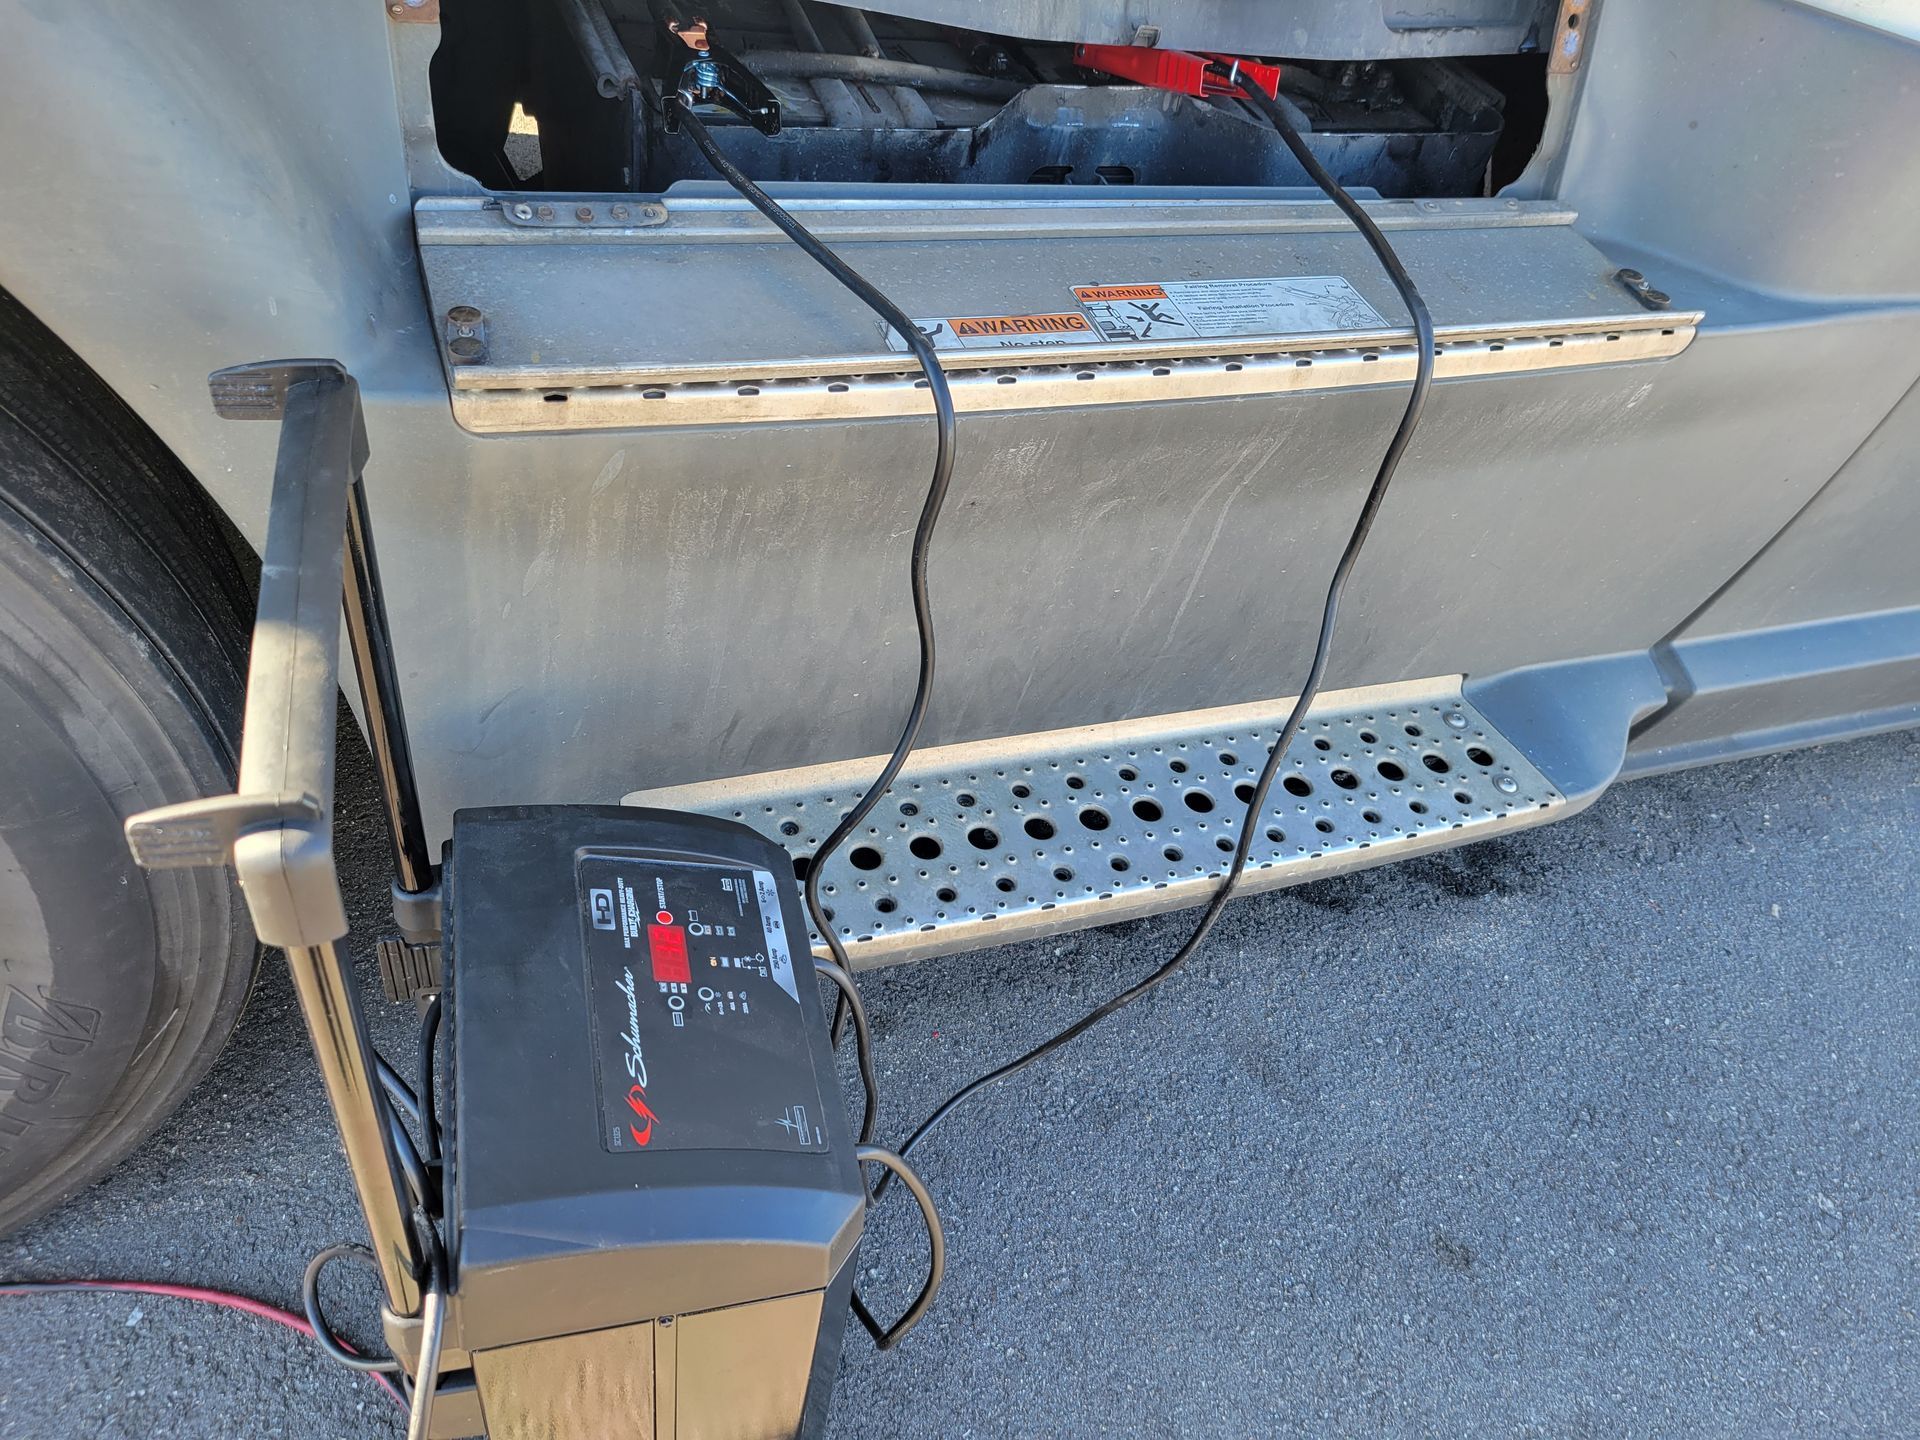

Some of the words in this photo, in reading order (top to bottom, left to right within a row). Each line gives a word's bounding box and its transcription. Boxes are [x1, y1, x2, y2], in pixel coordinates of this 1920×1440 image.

[1092, 288, 1163, 299] WARNING
[975, 316, 1087, 334] WARNING
[655, 877, 667, 910] START/STOP
[615, 968, 648, 1089] Schumacher
